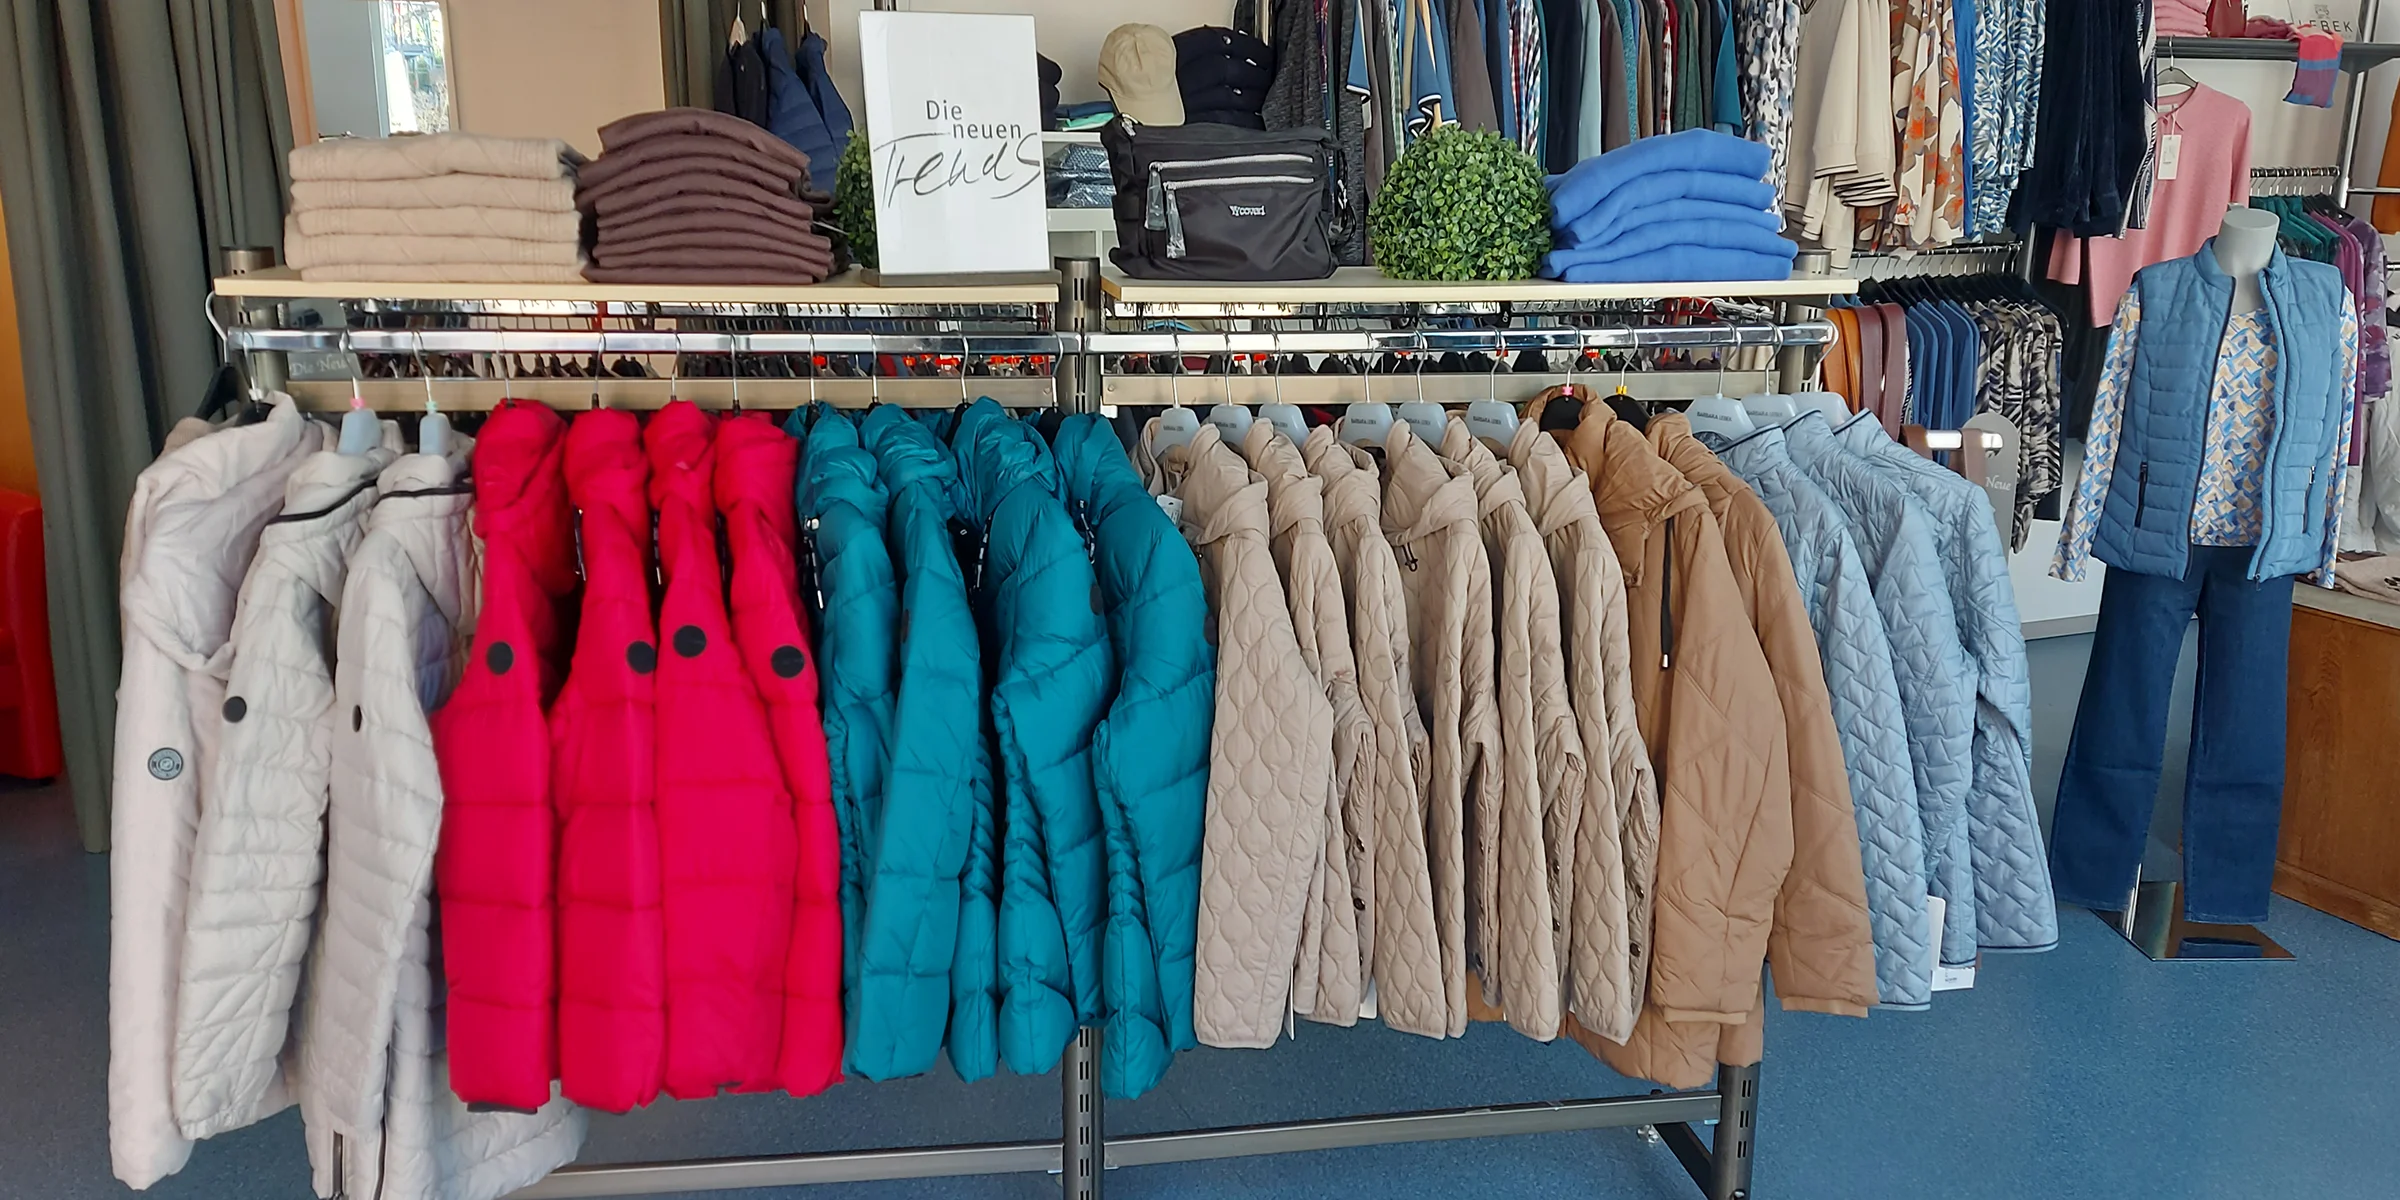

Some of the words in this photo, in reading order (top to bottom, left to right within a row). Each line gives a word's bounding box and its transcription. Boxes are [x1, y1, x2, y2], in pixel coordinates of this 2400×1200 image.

[925, 99, 963, 121] Die
[951, 122, 1022, 139] neuen
[291, 360, 314, 376] Die
[1985, 474, 2012, 491] Neue
